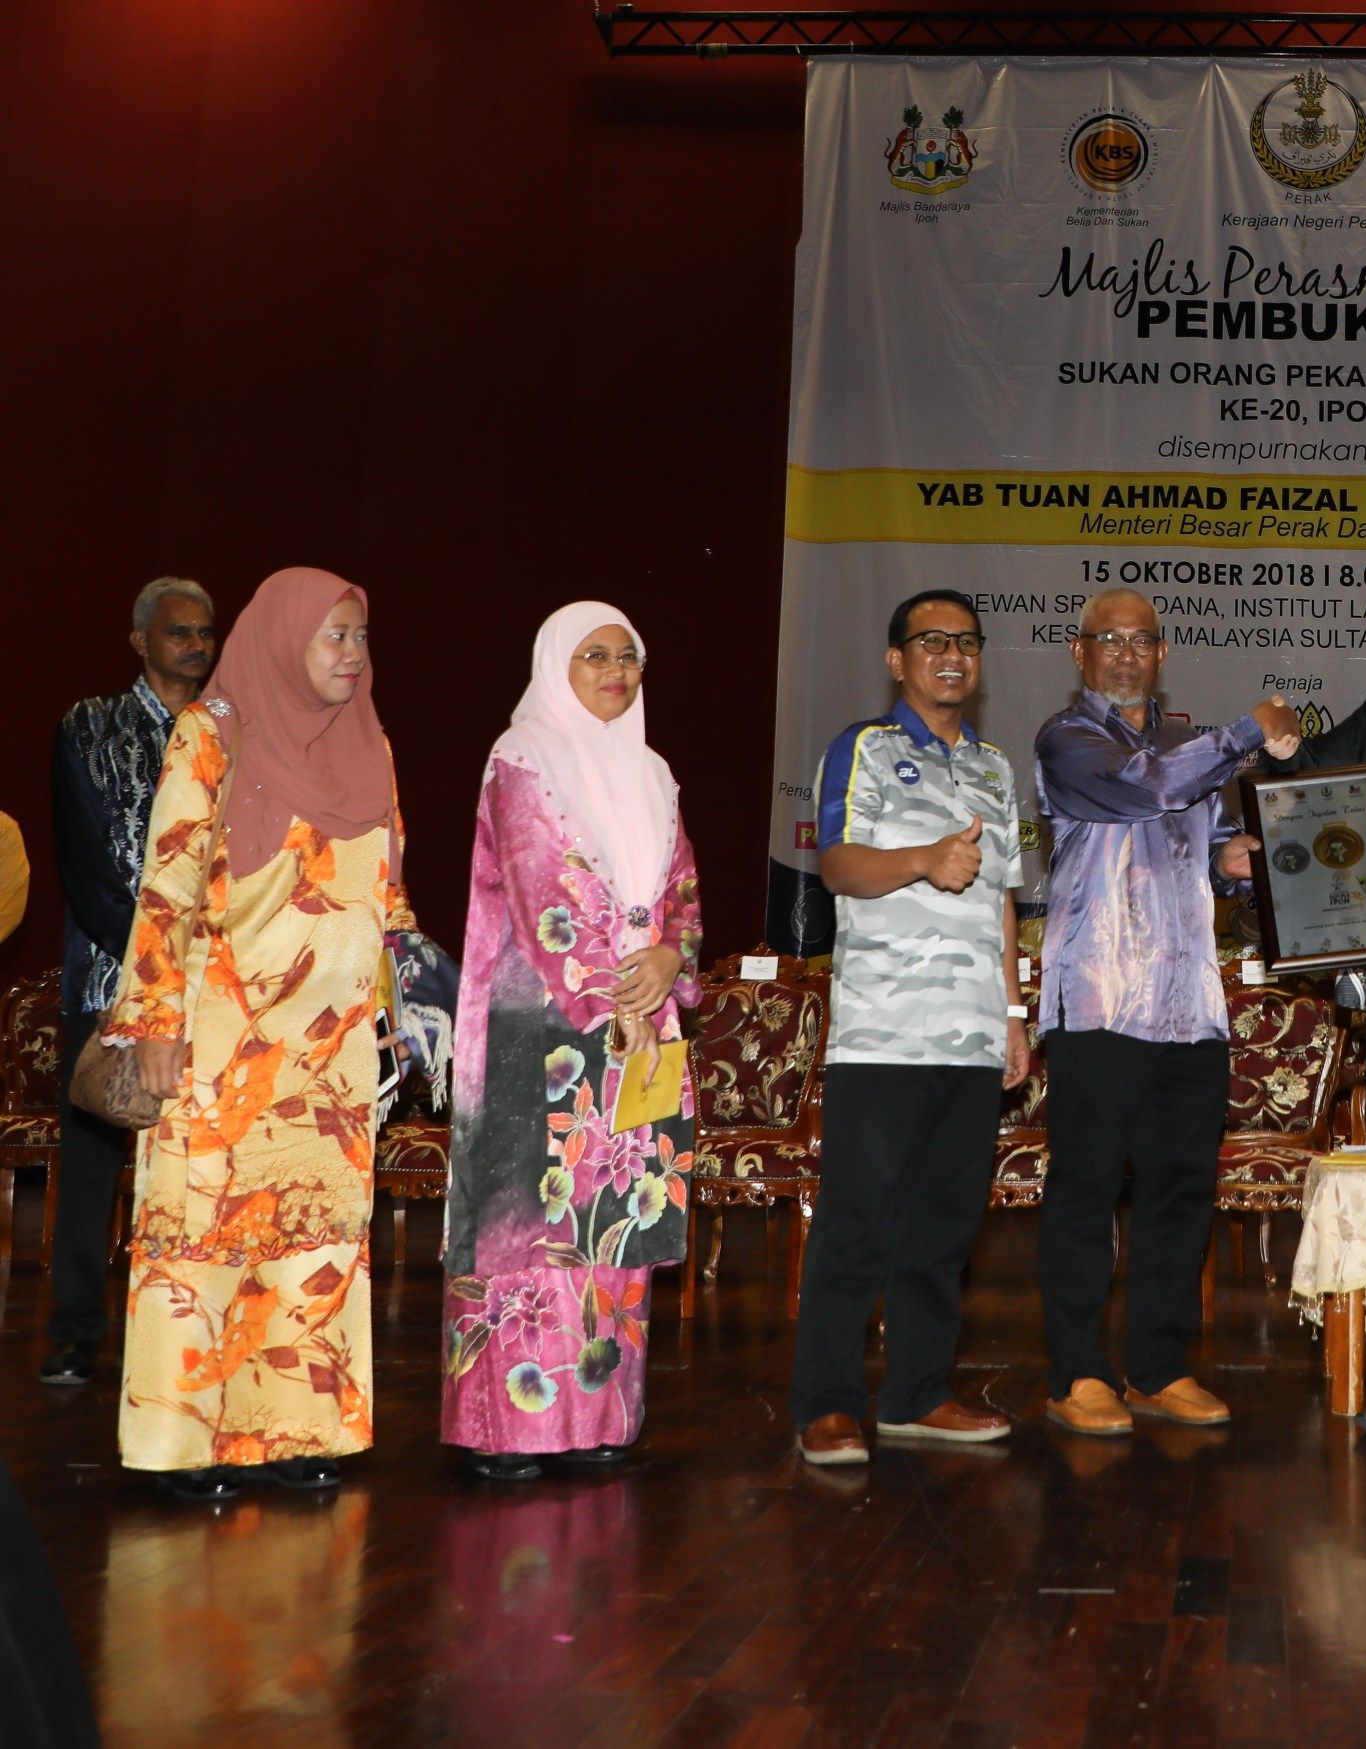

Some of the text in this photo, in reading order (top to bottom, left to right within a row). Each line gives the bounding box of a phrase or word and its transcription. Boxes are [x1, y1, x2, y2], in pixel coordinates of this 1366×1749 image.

[1094, 144, 1135, 163] KBS
[880, 201, 971, 214] Majlis Bandaraya
[1284, 192, 1333, 205] PERAK
[915, 213, 939, 224] Ipoh
[1066, 216, 1149, 228] Belia Dan Sukan
[1076, 206, 1139, 217] Kementerian
[1222, 212, 1289, 230] Kerajaan
[1293, 214, 1344, 231] Negeri
[1038, 238, 1211, 319] Majlis
[1058, 361, 1160, 385] SUKAN
[1169, 361, 1276, 387] ORANG
[1219, 398, 1309, 426] KE-20,
[916, 482, 985, 507] YAB
[995, 483, 1091, 508] TUAN
[1101, 484, 1228, 511] AHMAD
[1239, 486, 1359, 513] FAIZAL
[1079, 512, 1173, 536] Menteri
[1179, 513, 1253, 538] Besar
[1258, 515, 1330, 539] Perak
[1080, 560, 1110, 583] 15
[1119, 561, 1244, 586] OKTOBER
[1252, 563, 1315, 587] 2018
[1153, 595, 1226, 619] DANA,
[1234, 597, 1343, 619] INSTITUT
[1174, 626, 1294, 648] MALAYSIA
[1262, 673, 1323, 694] Penaja
